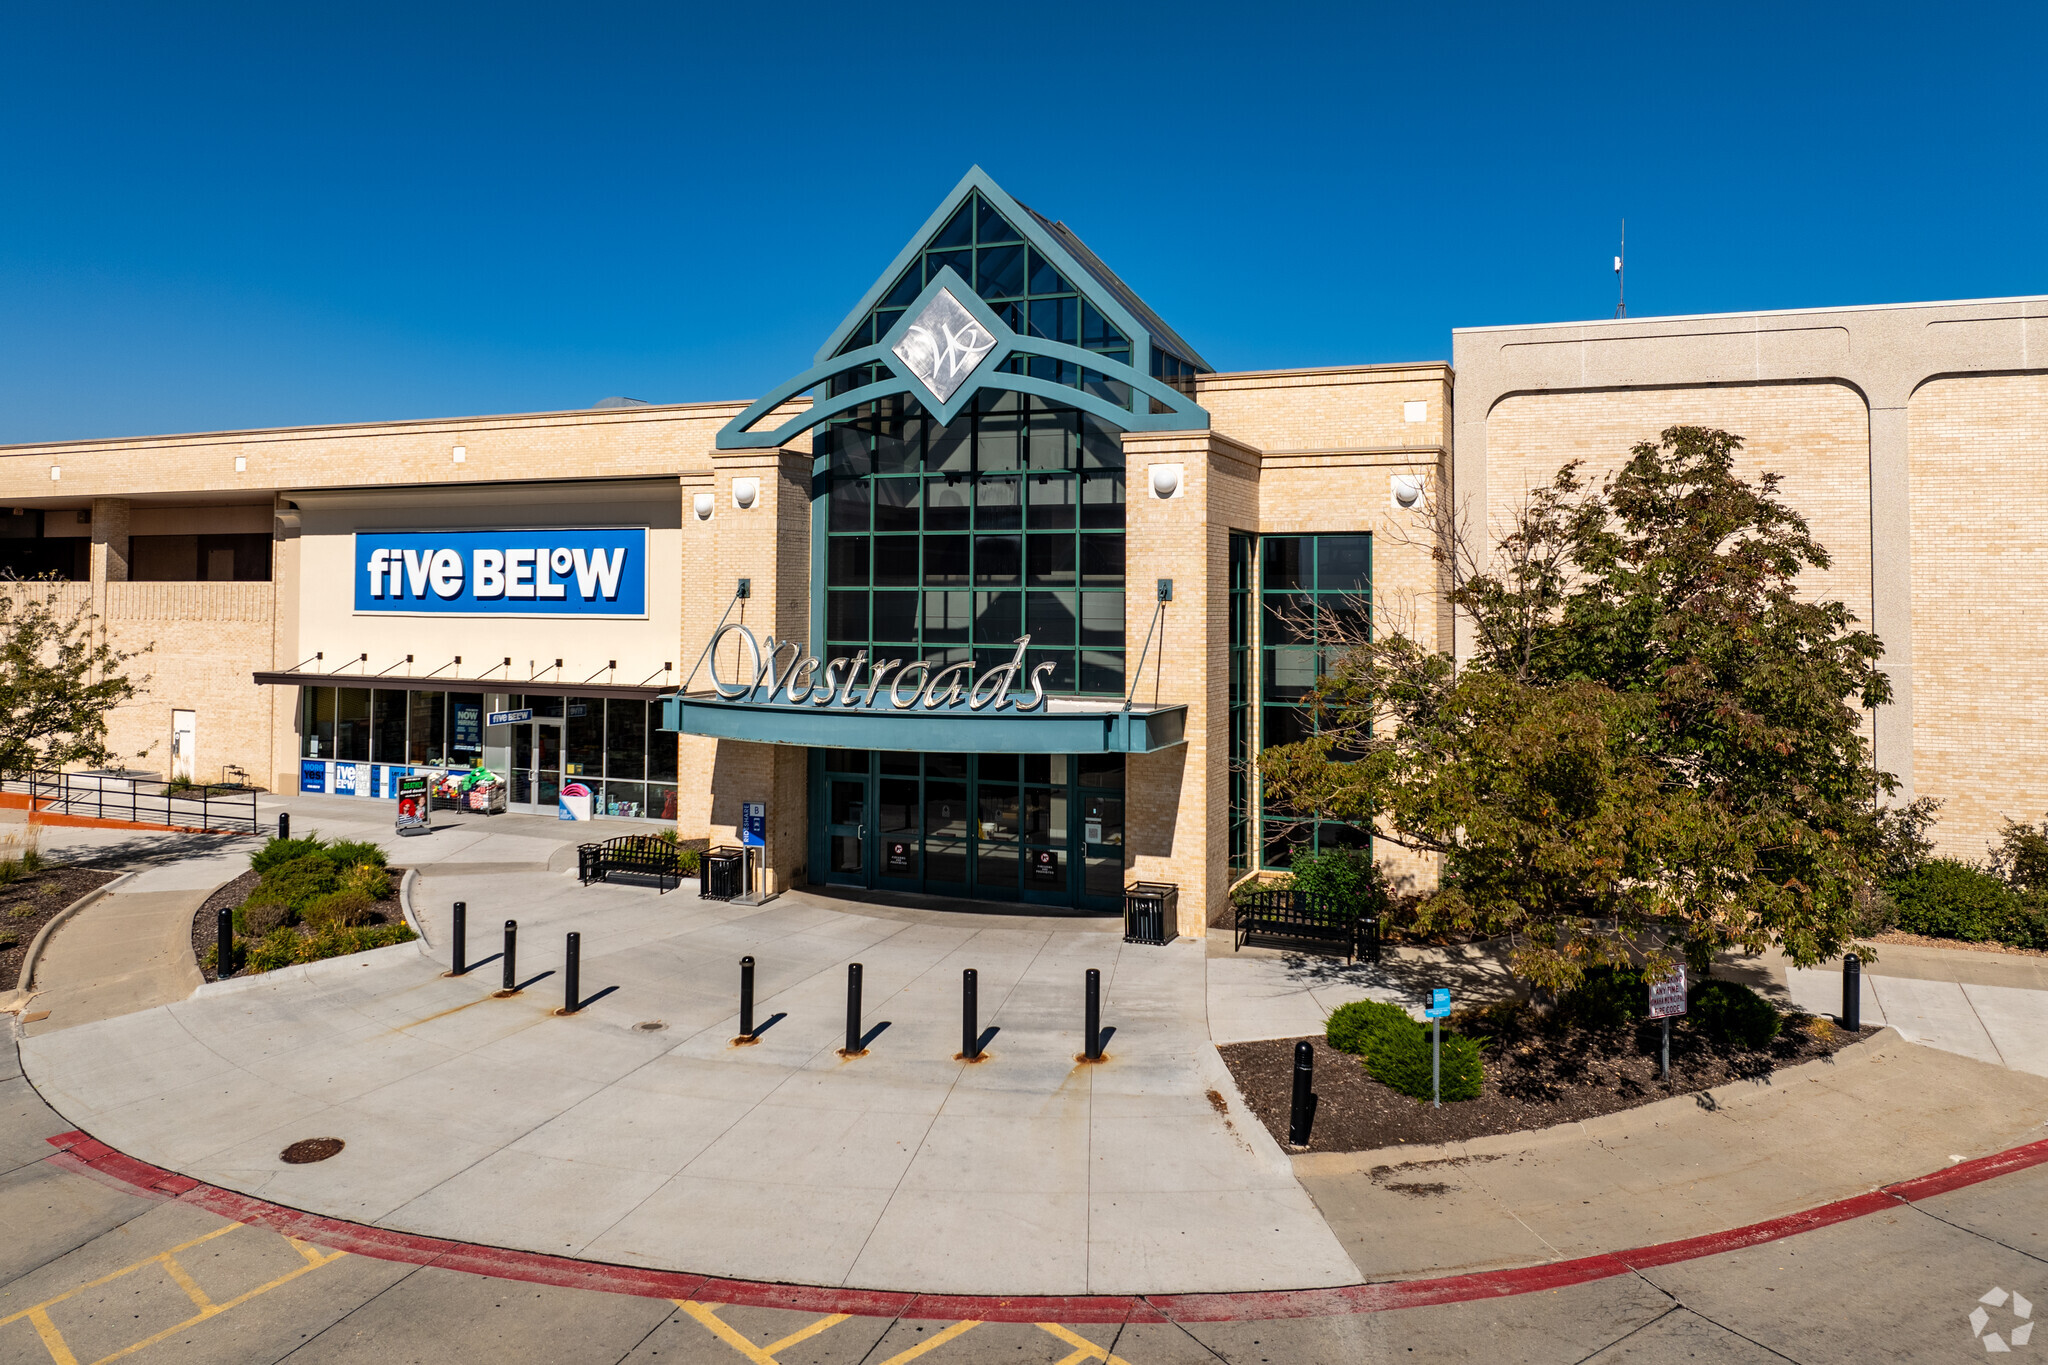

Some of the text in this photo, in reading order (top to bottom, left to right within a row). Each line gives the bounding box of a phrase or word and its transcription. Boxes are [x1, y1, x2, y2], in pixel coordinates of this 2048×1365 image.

[367, 547, 627, 600] five BELOW
[709, 624, 1057, 710] Westroads
[457, 711, 478, 720] NOW
[492, 715, 507, 723] five
[754, 806, 760, 815] B
[1656, 986, 1666, 995] ANY
